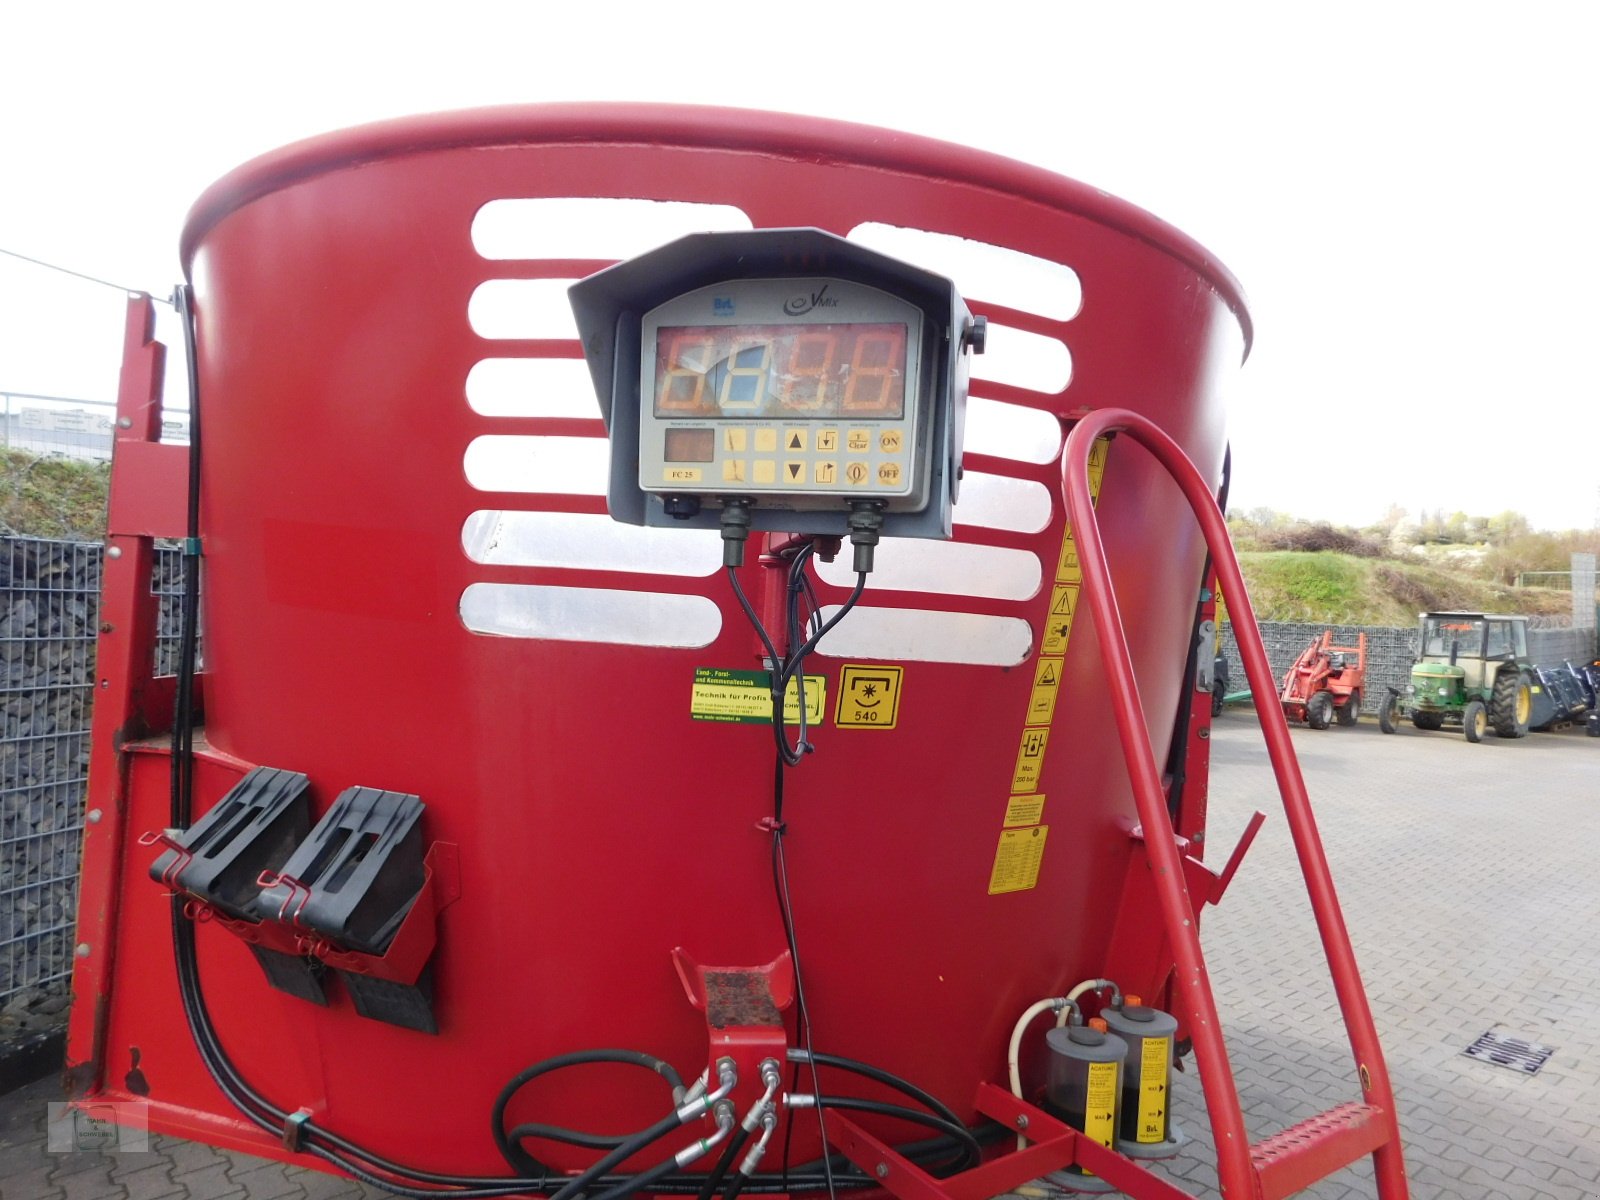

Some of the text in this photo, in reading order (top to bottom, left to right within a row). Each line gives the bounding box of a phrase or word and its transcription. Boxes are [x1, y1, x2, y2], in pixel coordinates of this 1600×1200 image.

[848, 441, 868, 449] Clear
[882, 437, 899, 447] ON
[879, 469, 899, 479] OFF
[696, 691, 726, 699] Technik
[743, 694, 767, 702] Profis
[854, 711, 877, 722] 540
